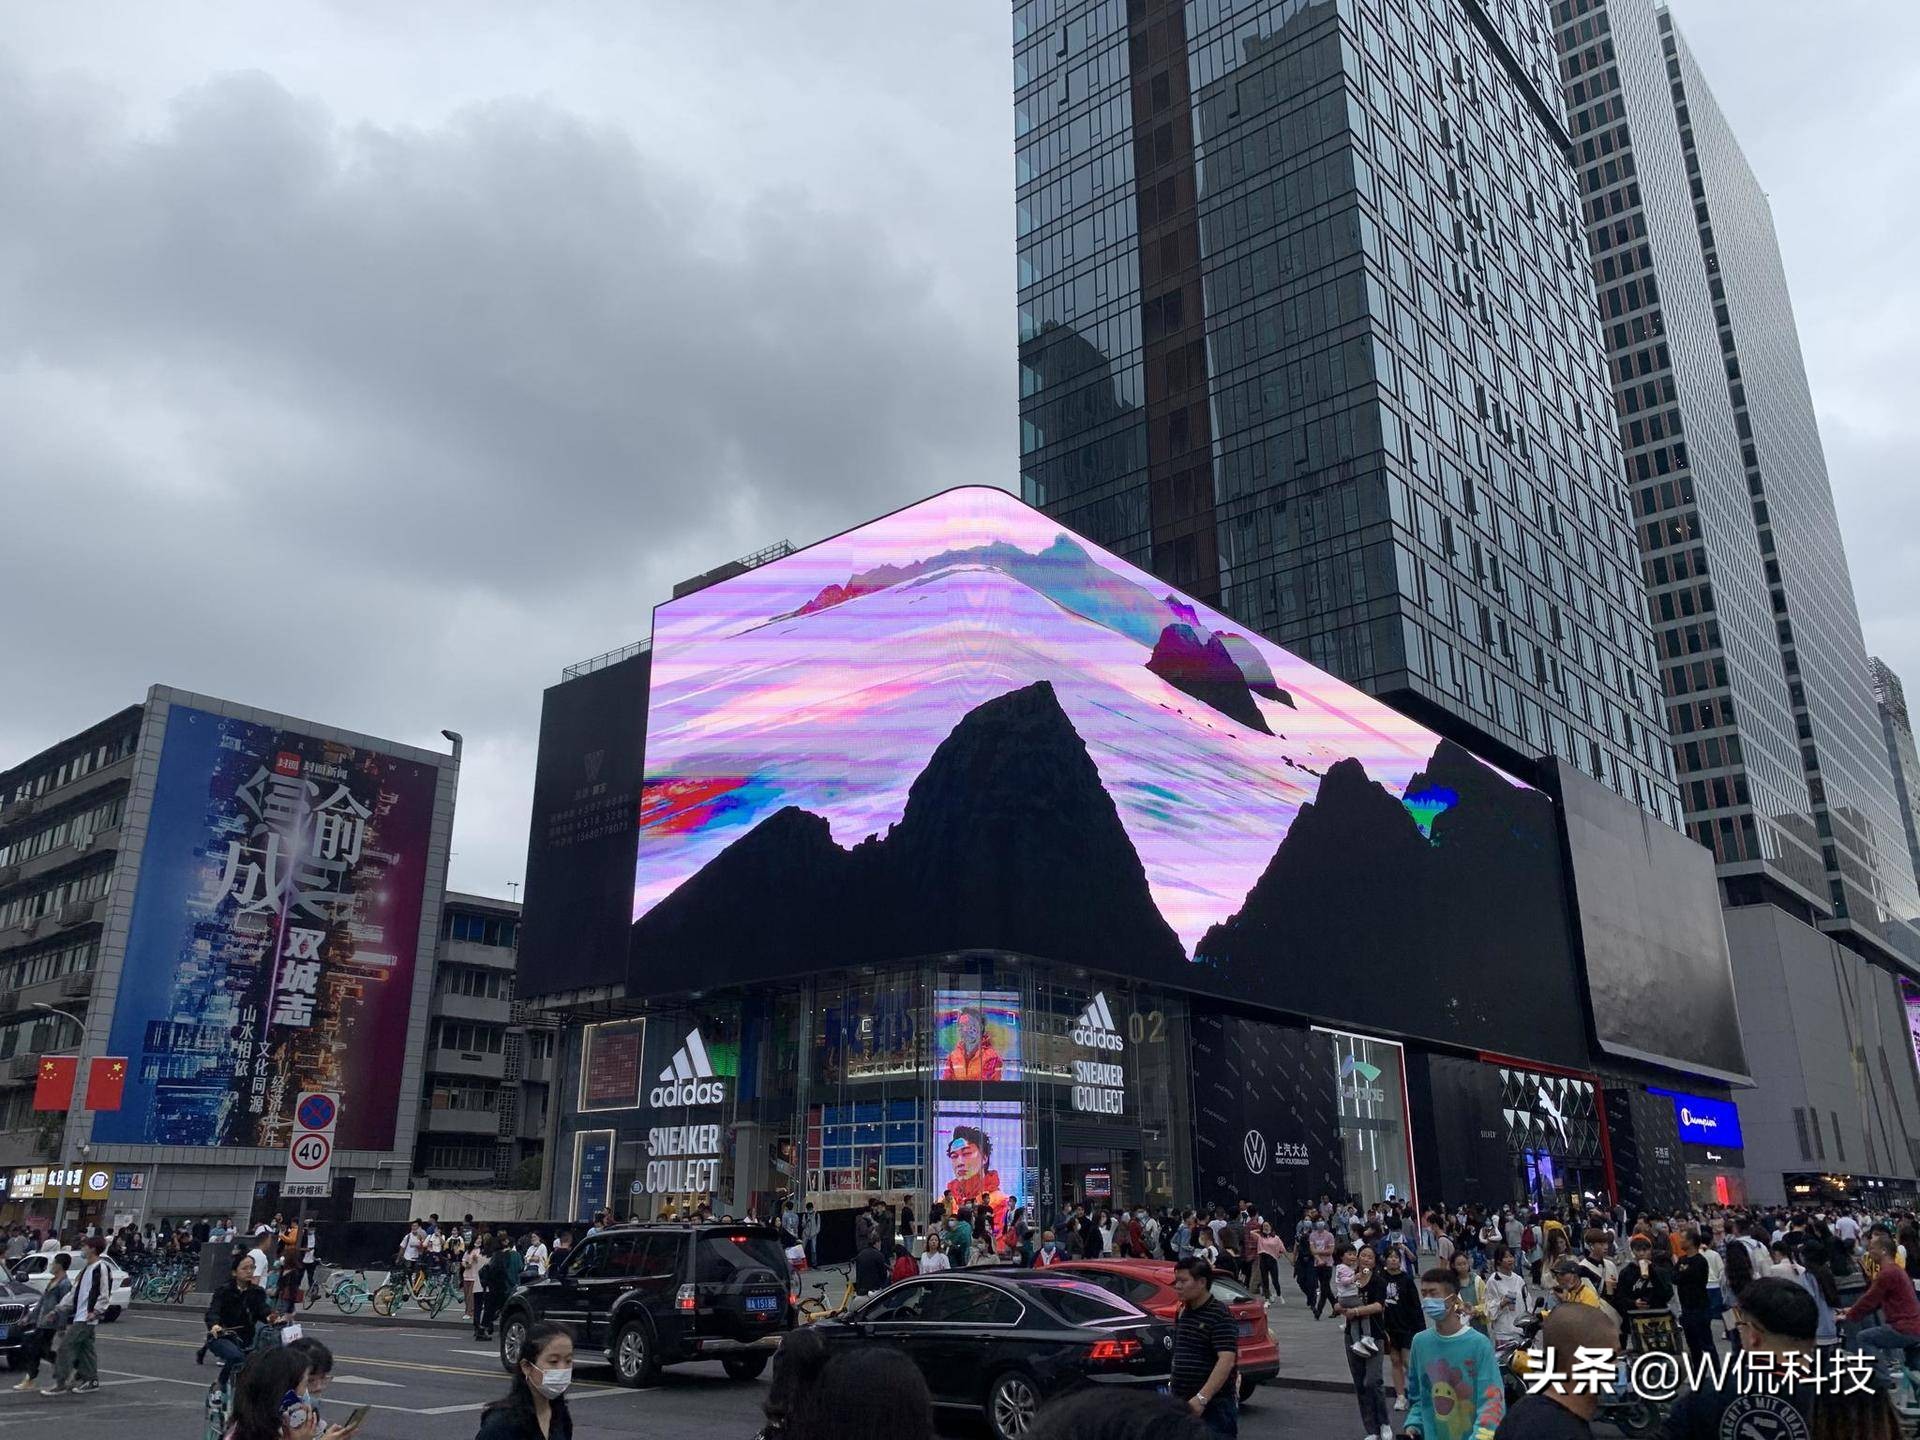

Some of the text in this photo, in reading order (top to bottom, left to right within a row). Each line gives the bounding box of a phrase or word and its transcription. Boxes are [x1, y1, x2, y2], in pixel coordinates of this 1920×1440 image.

[271, 926, 328, 1028] 双城志
[234, 1004, 258, 1078] 山水相依
[1073, 1026, 1124, 1052] adidas
[248, 1040, 273, 1114] 文化同源
[1074, 1060, 1125, 1088] SNEAKER
[650, 1077, 724, 1108] adidas
[1074, 1087, 1126, 1115] COLLECT
[298, 1142, 322, 1161] 40
[648, 1124, 719, 1157] SNEAKER
[1275, 1141, 1309, 1158] 上汽大众
[646, 1158, 720, 1194] COLLECT
